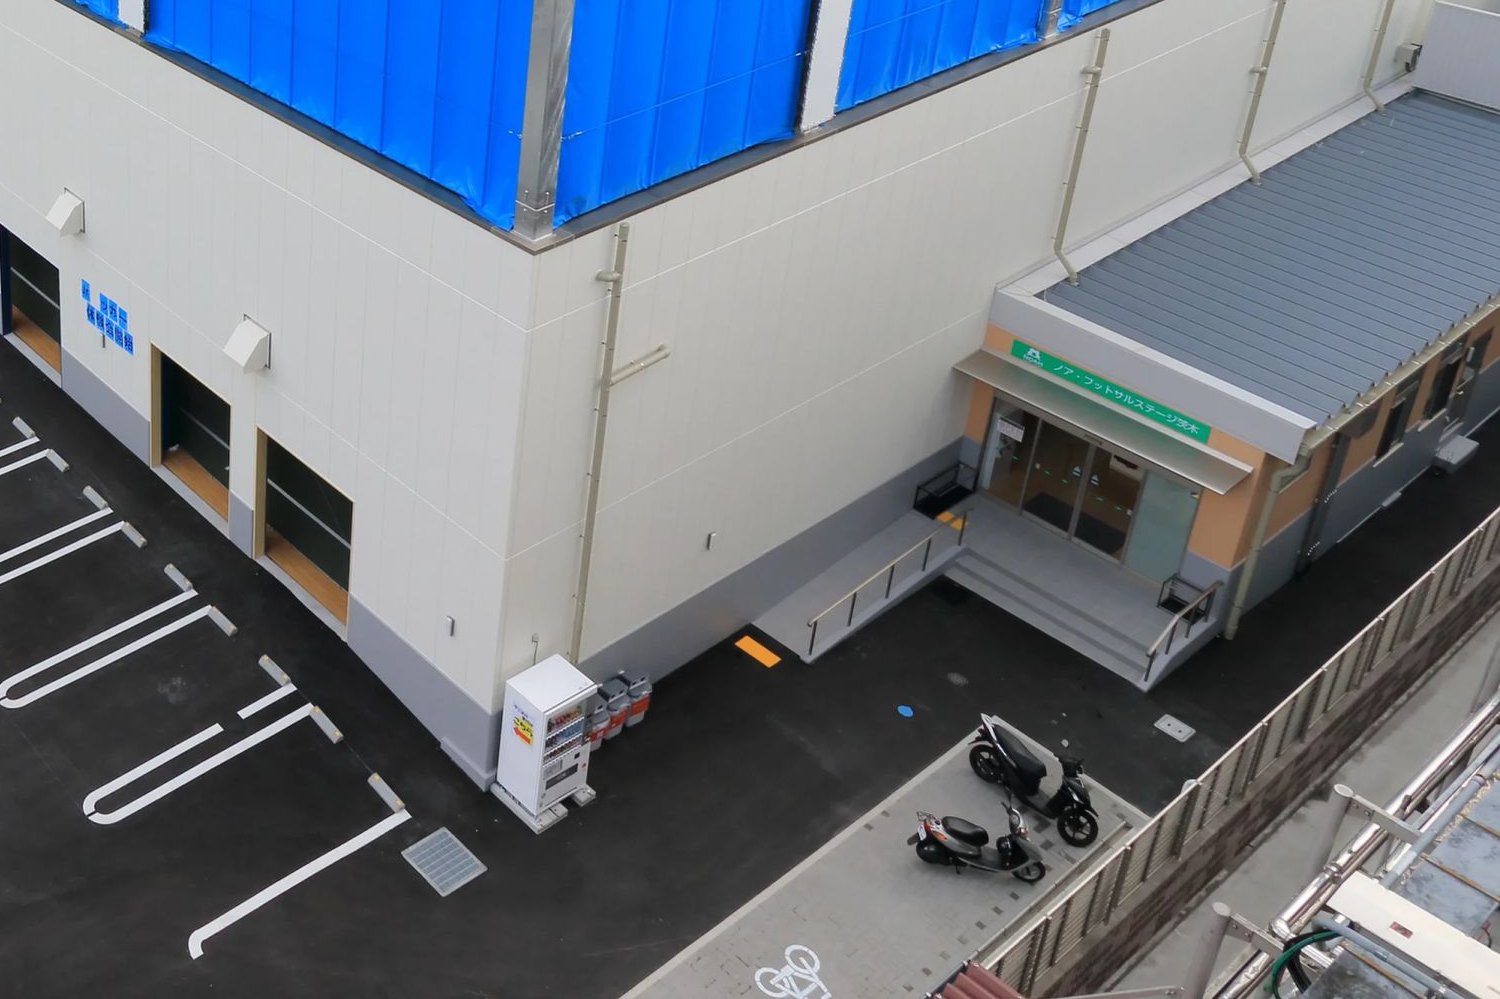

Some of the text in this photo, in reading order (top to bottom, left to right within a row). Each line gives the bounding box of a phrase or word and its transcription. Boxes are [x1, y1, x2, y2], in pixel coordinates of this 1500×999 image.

[1053, 364, 1200, 435] ノア・フットサルステージ茨木
